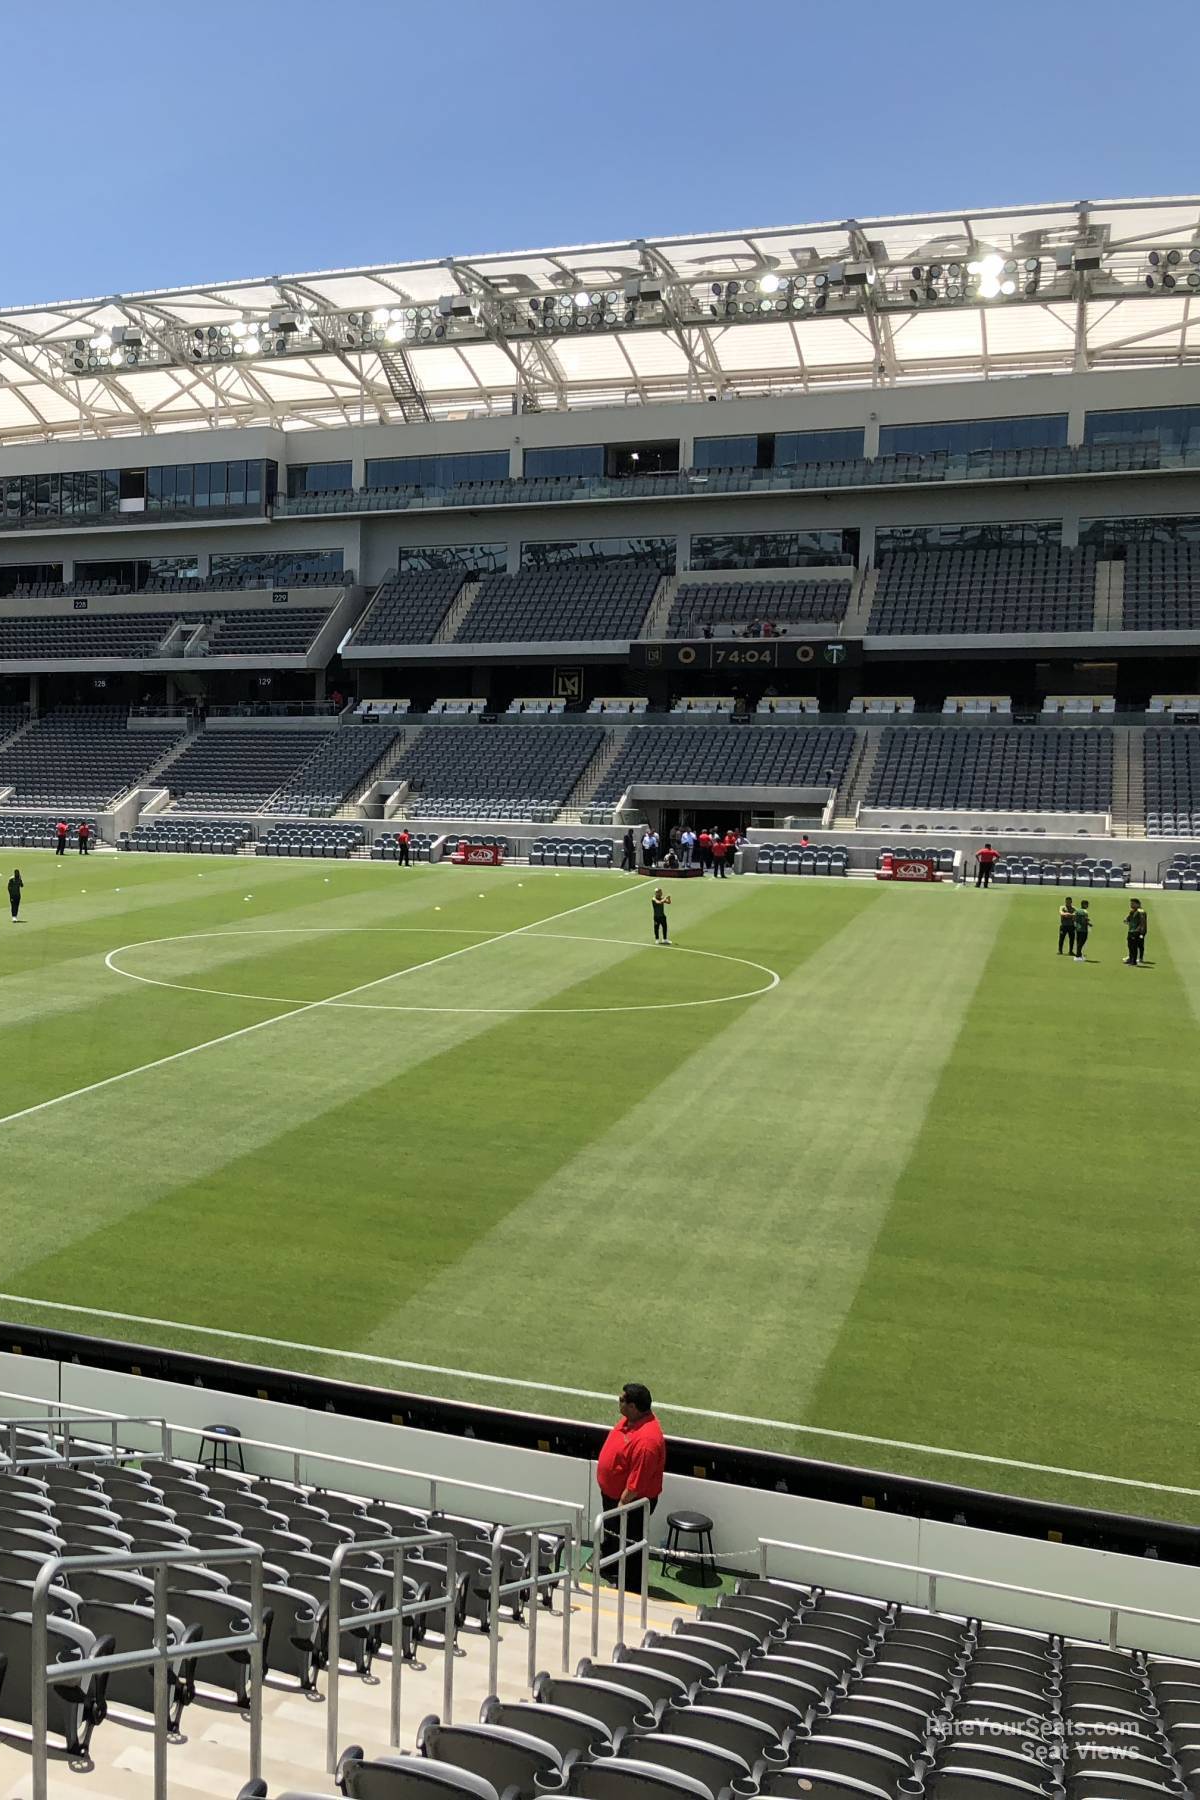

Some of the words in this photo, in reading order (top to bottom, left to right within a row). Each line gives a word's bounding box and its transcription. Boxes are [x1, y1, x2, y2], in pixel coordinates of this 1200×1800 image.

[274, 593, 286, 603] 229
[716, 650, 771, 663] 74:04
[259, 678, 271, 686] 129
